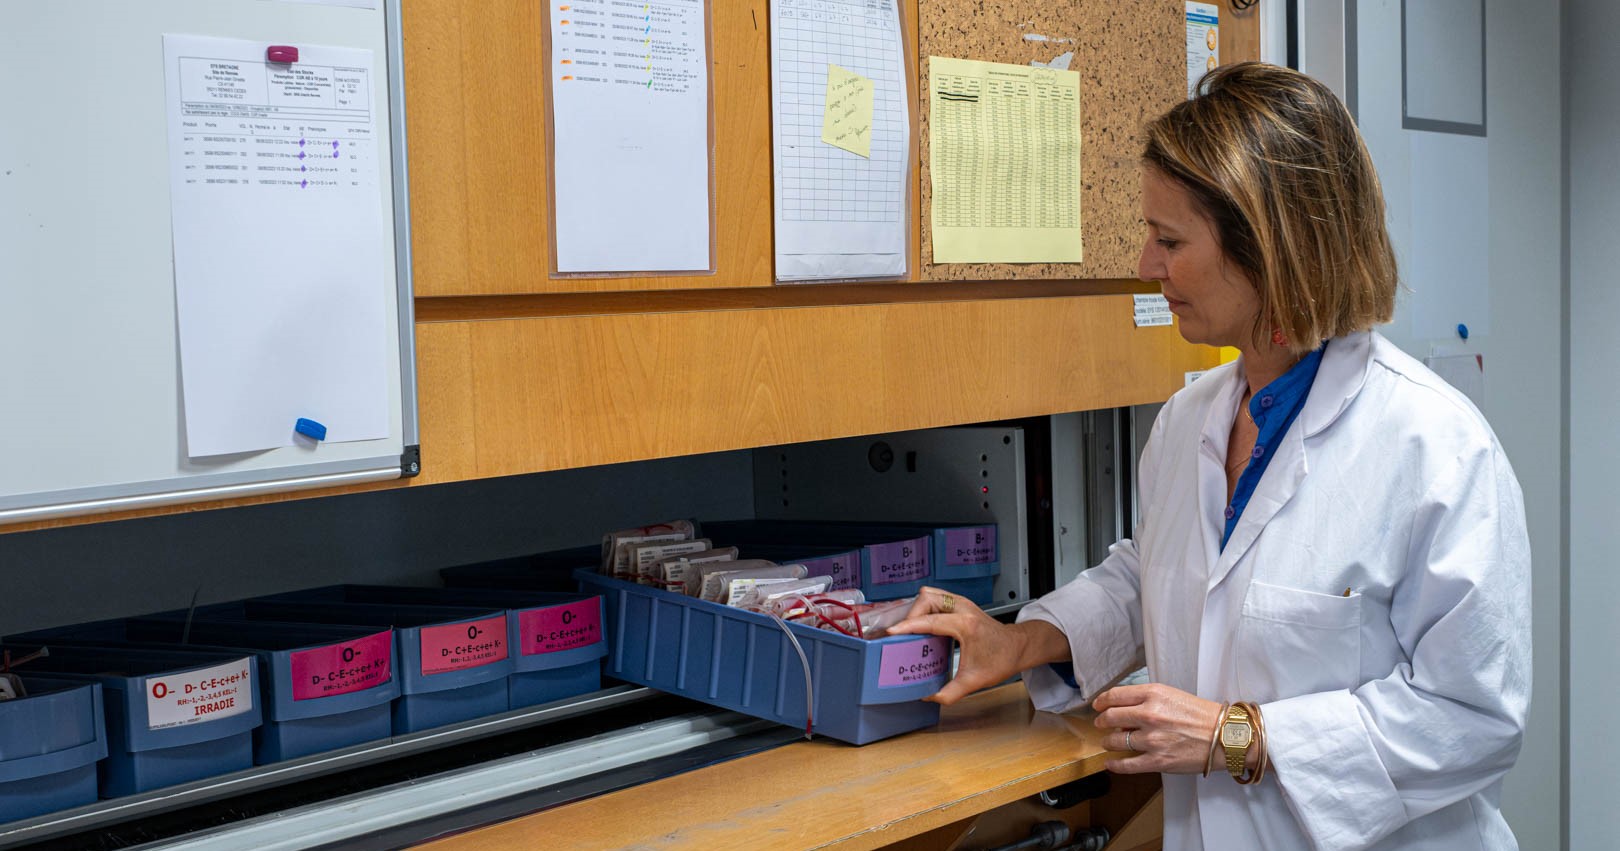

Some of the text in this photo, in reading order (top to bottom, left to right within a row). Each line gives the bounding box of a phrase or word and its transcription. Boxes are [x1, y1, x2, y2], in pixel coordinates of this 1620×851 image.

[562, 610, 577, 625] O-
[468, 626, 483, 640] O-
[342, 648, 361, 662] O-
[441, 648, 453, 657] D-
[455, 642, 493, 656] C+E-c+e+
[922, 645, 934, 658] B-
[312, 675, 325, 685] D-
[328, 664, 371, 681] C-E-c+e+
[898, 666, 908, 675] D-
[152, 670, 249, 699] O- D- C-E-c+e+ K-
[194, 698, 234, 716] IRRADIE
